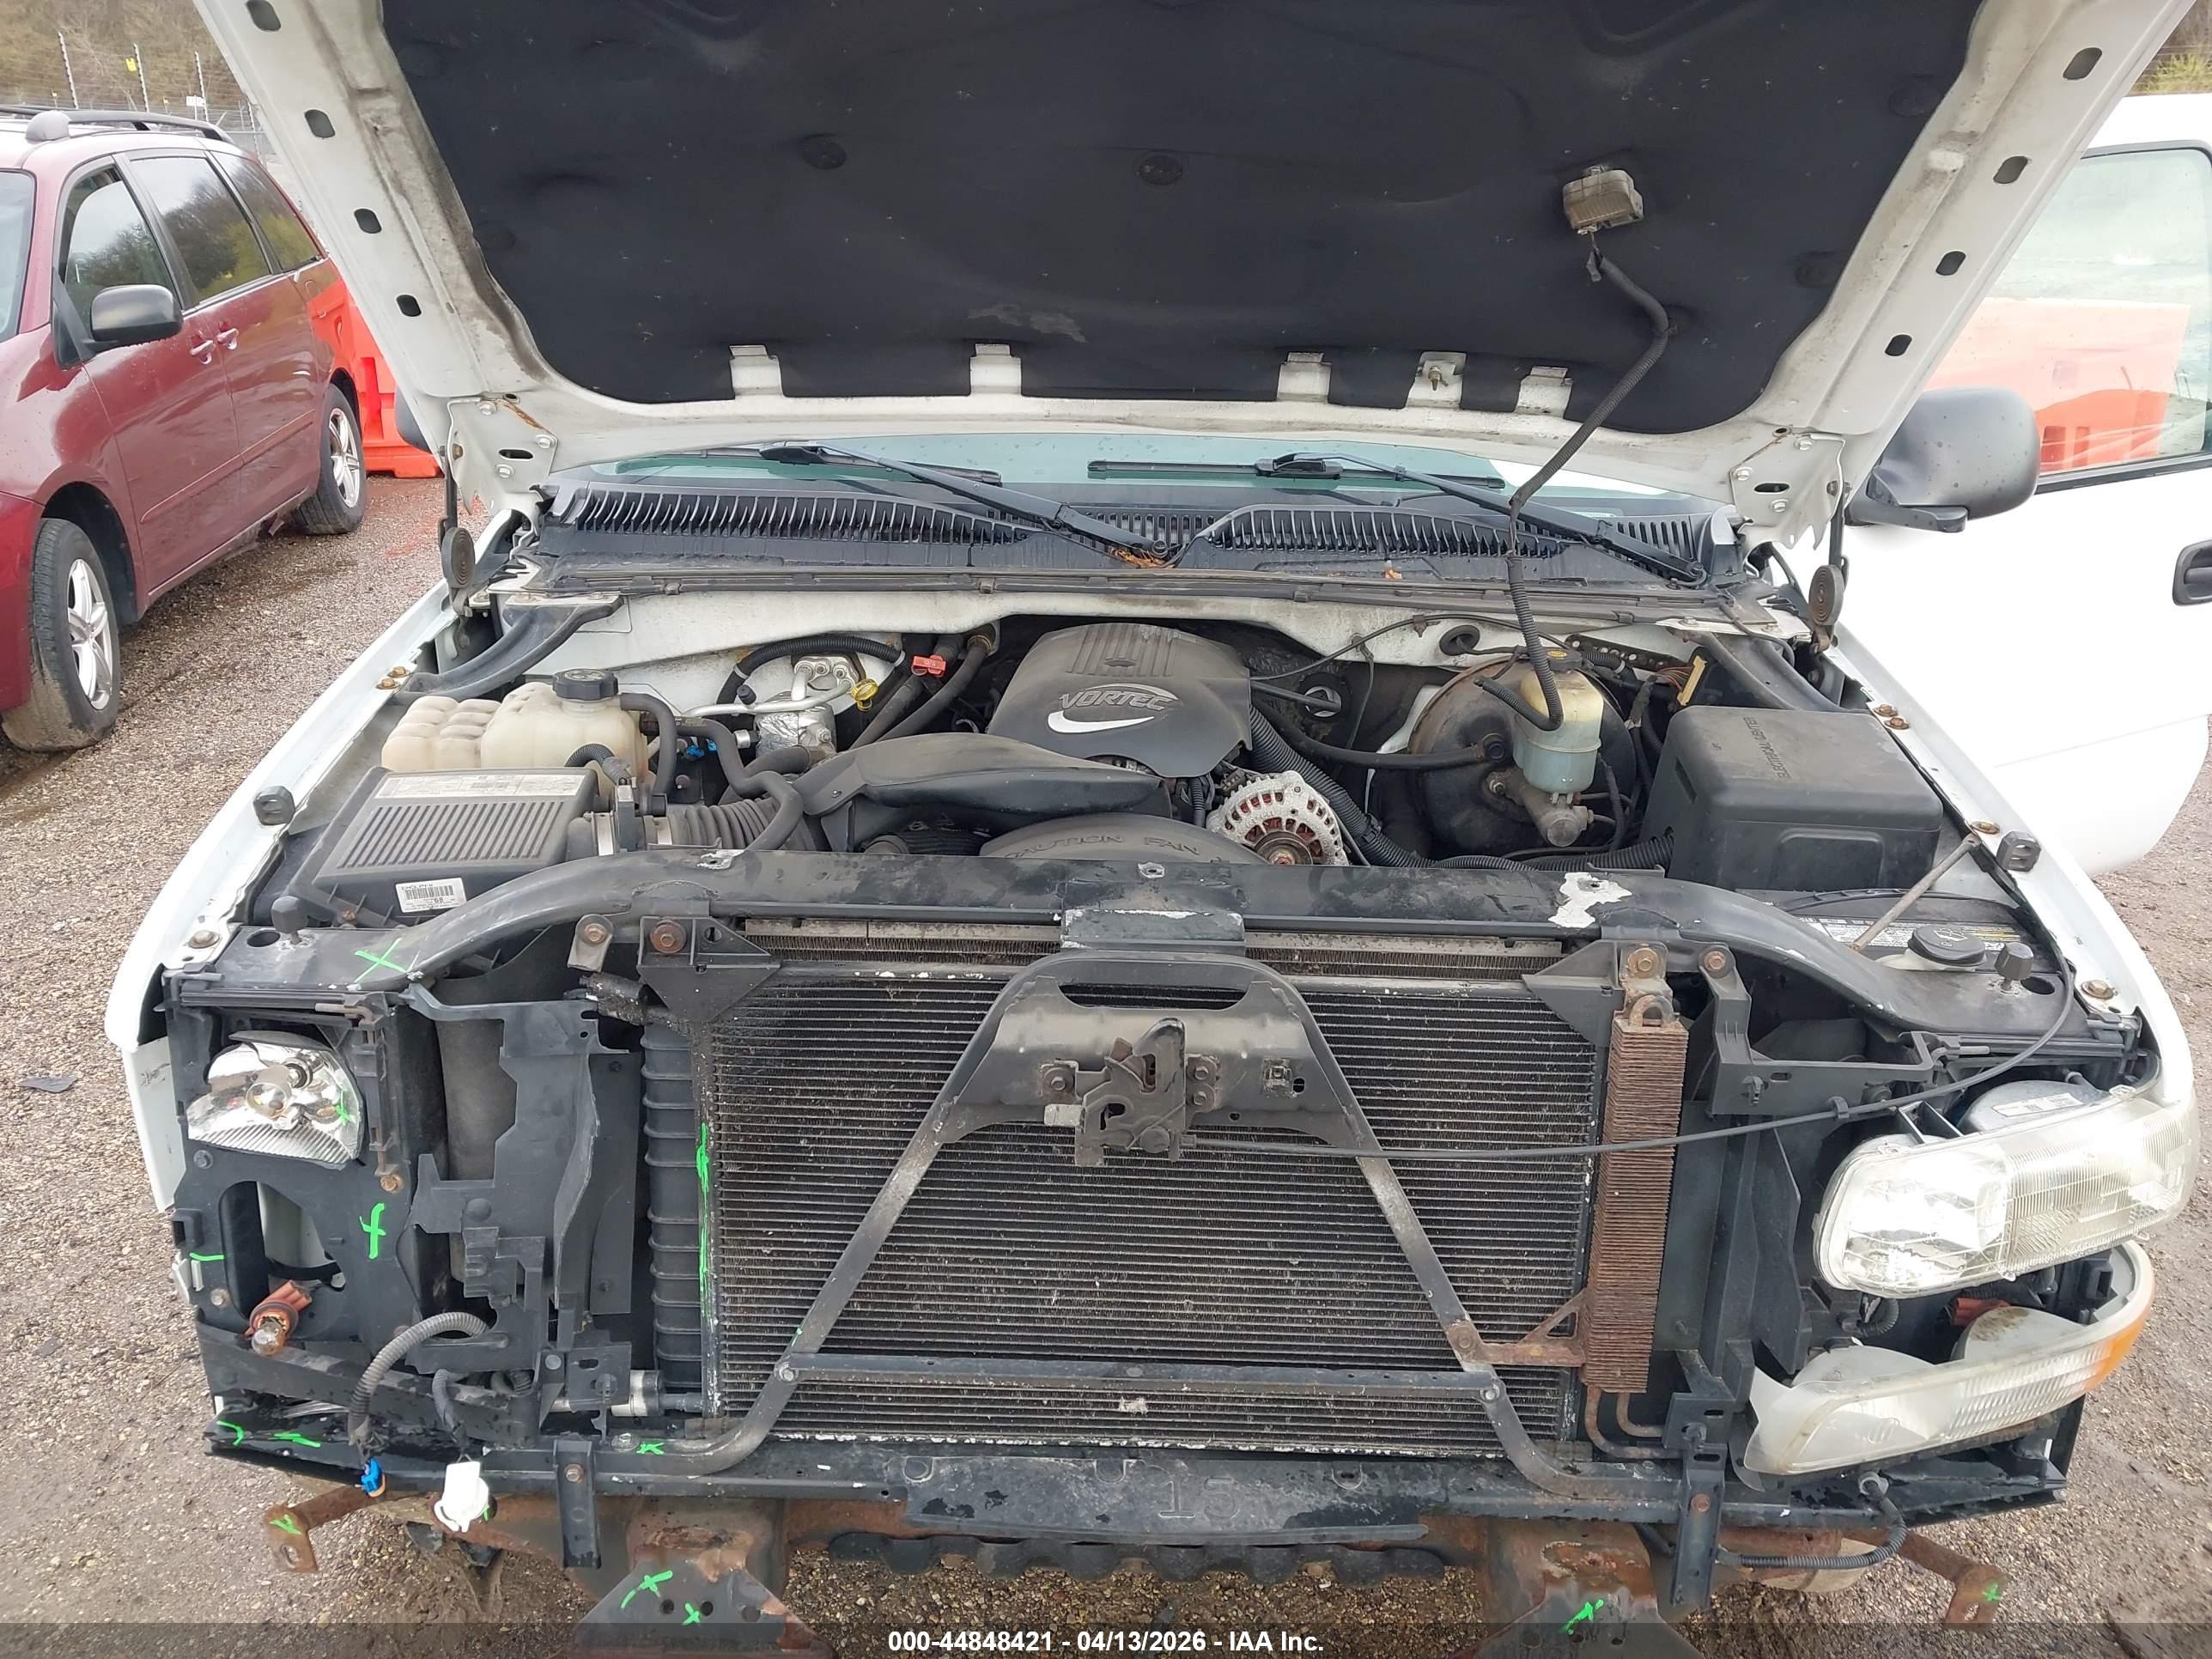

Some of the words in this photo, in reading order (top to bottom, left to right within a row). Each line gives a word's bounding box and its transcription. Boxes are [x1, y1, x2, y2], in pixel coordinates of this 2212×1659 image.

[1059, 690, 1172, 711] VORTEC
[1743, 716, 1767, 740] CENTER
[1758, 742, 1791, 779] ELECTRICAL
[1144, 836, 1200, 855] FAN
